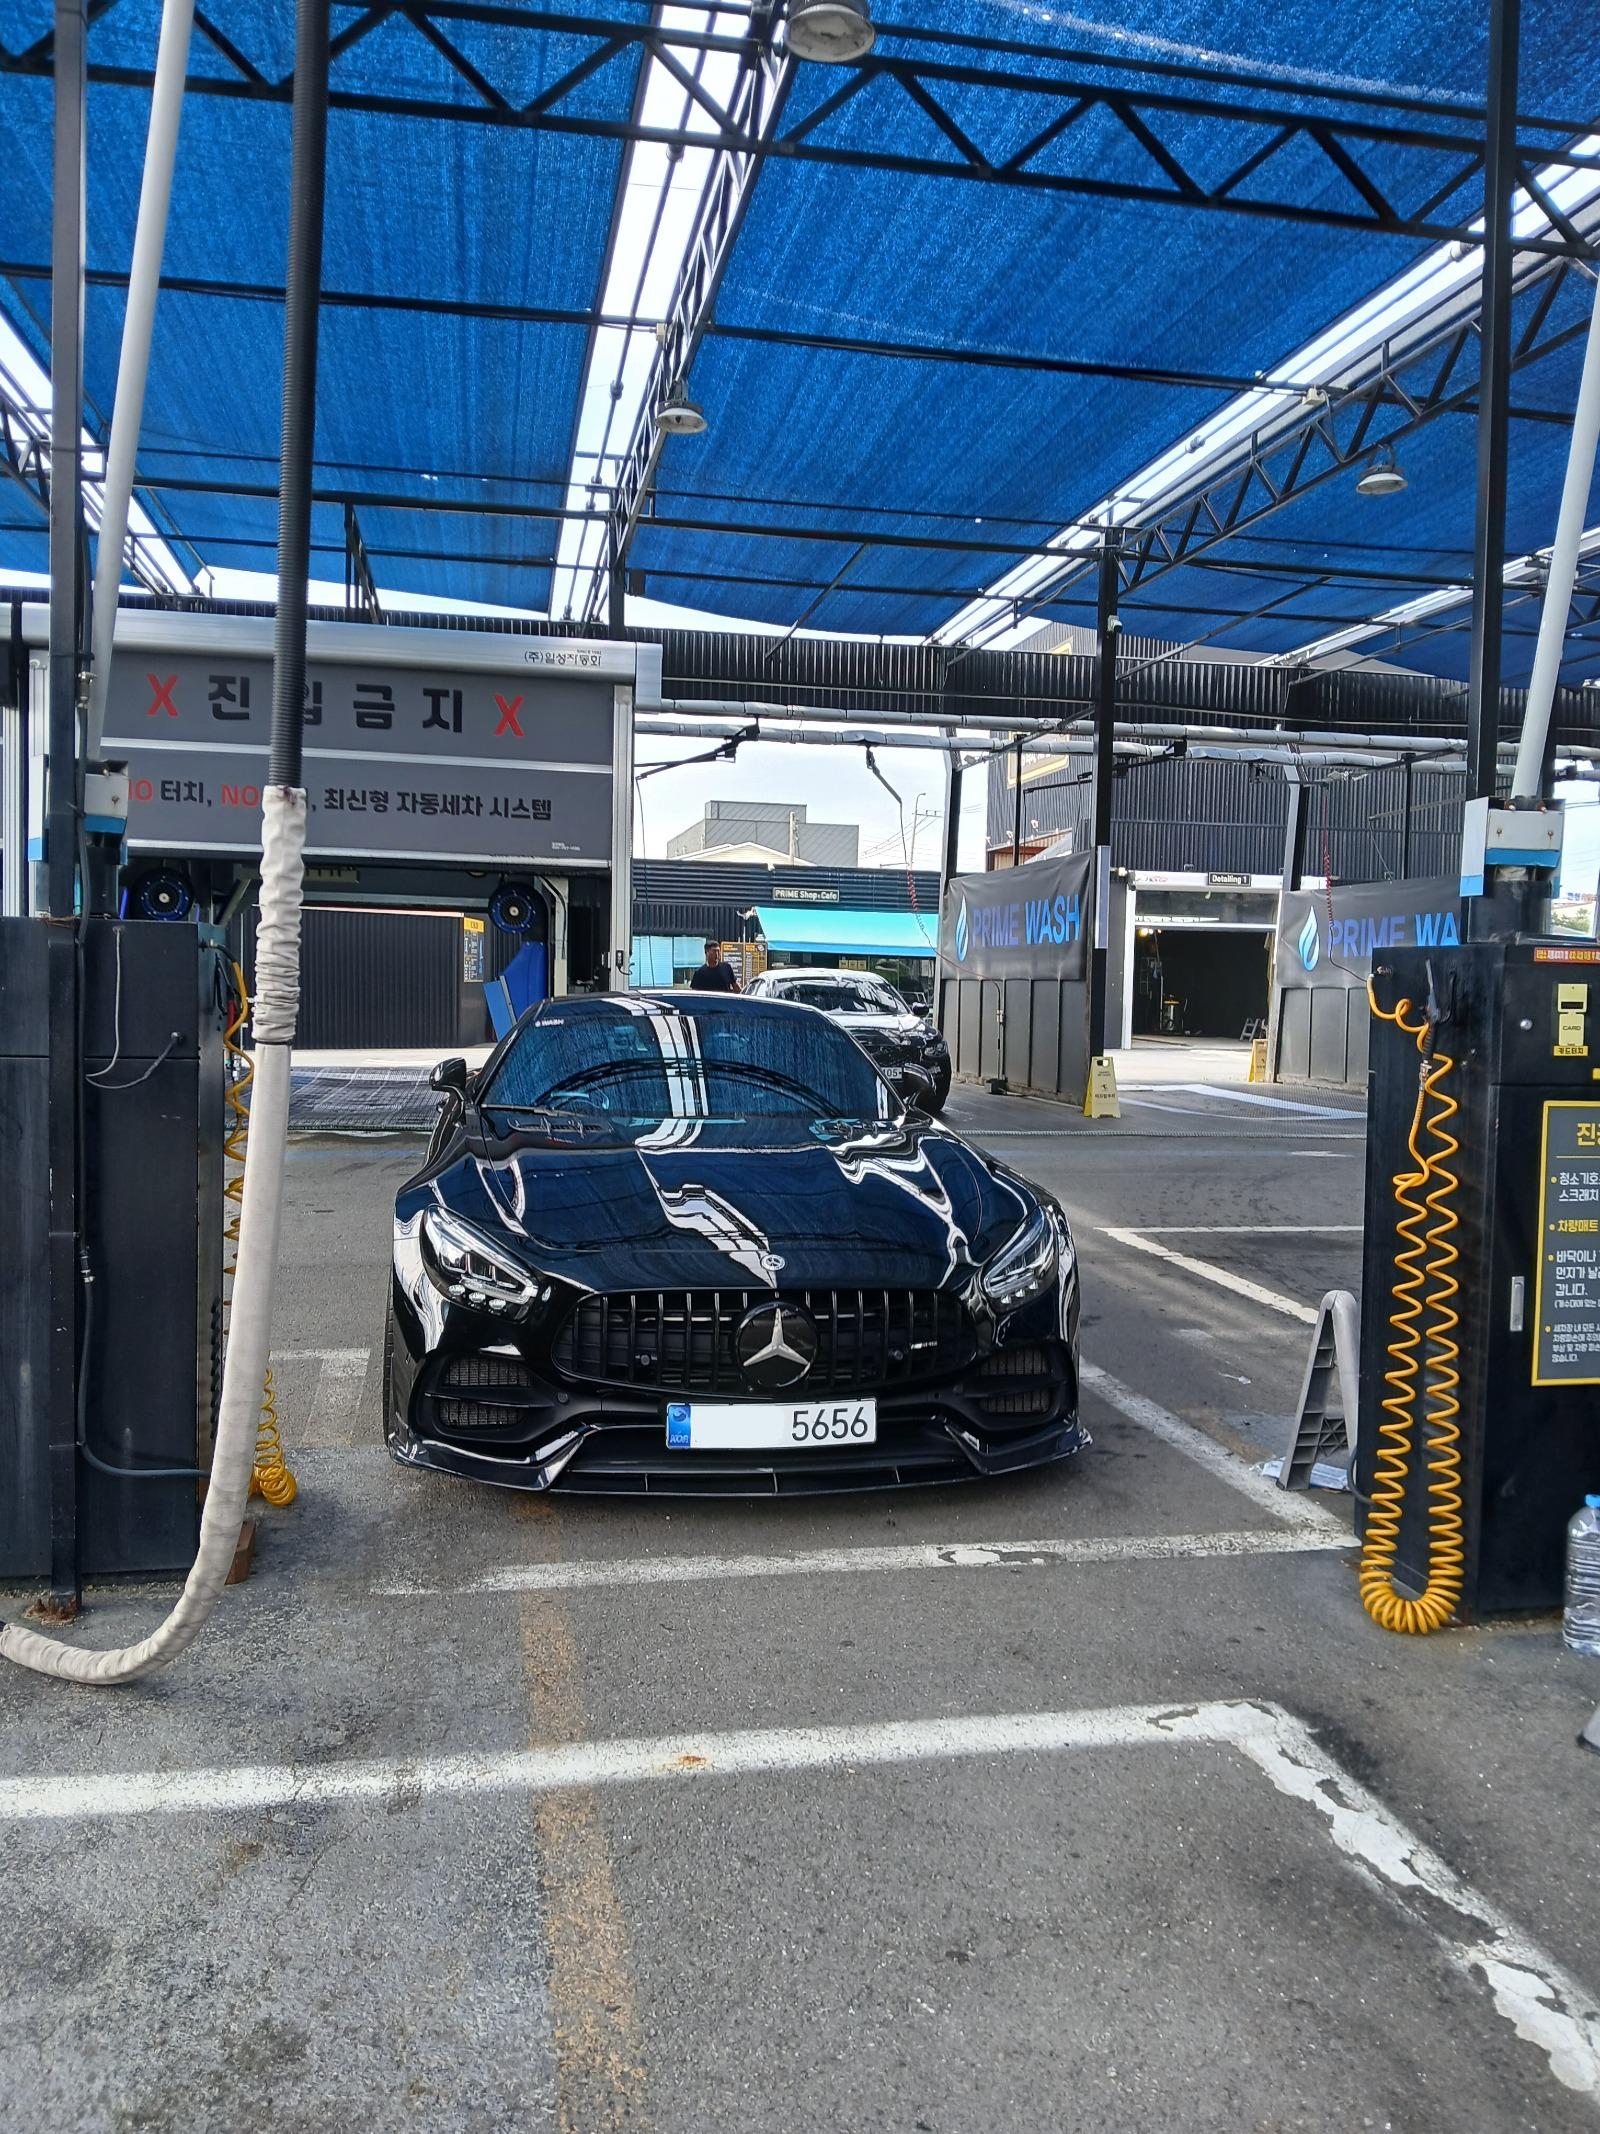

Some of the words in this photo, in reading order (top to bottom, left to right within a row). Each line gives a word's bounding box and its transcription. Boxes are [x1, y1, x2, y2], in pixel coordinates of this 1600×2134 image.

[161, 779, 212, 807] 터치,
[324, 788, 389, 813] 최신형
[397, 791, 483, 817] 자동세차
[489, 798, 552, 821] 시스템
[1212, 874, 1242, 885] Detailing
[775, 889, 799, 898] PRIME
[799, 890, 817, 900] Shop
[972, 904, 1020, 948] PRIME
[1025, 890, 1080, 945] WASH
[1328, 915, 1406, 958] PRIME
[1577, 1122, 1600, 1146] 진
[1560, 1172, 1600, 1186] 청소기호
[1559, 1188, 1599, 1202] 스크래치
[1556, 1250, 1596, 1263] 바닥이나
[1556, 1266, 1585, 1280] 먼지가
[1555, 1283, 1588, 1297] 갑니다.
[792, 1407, 868, 1441] 5656
